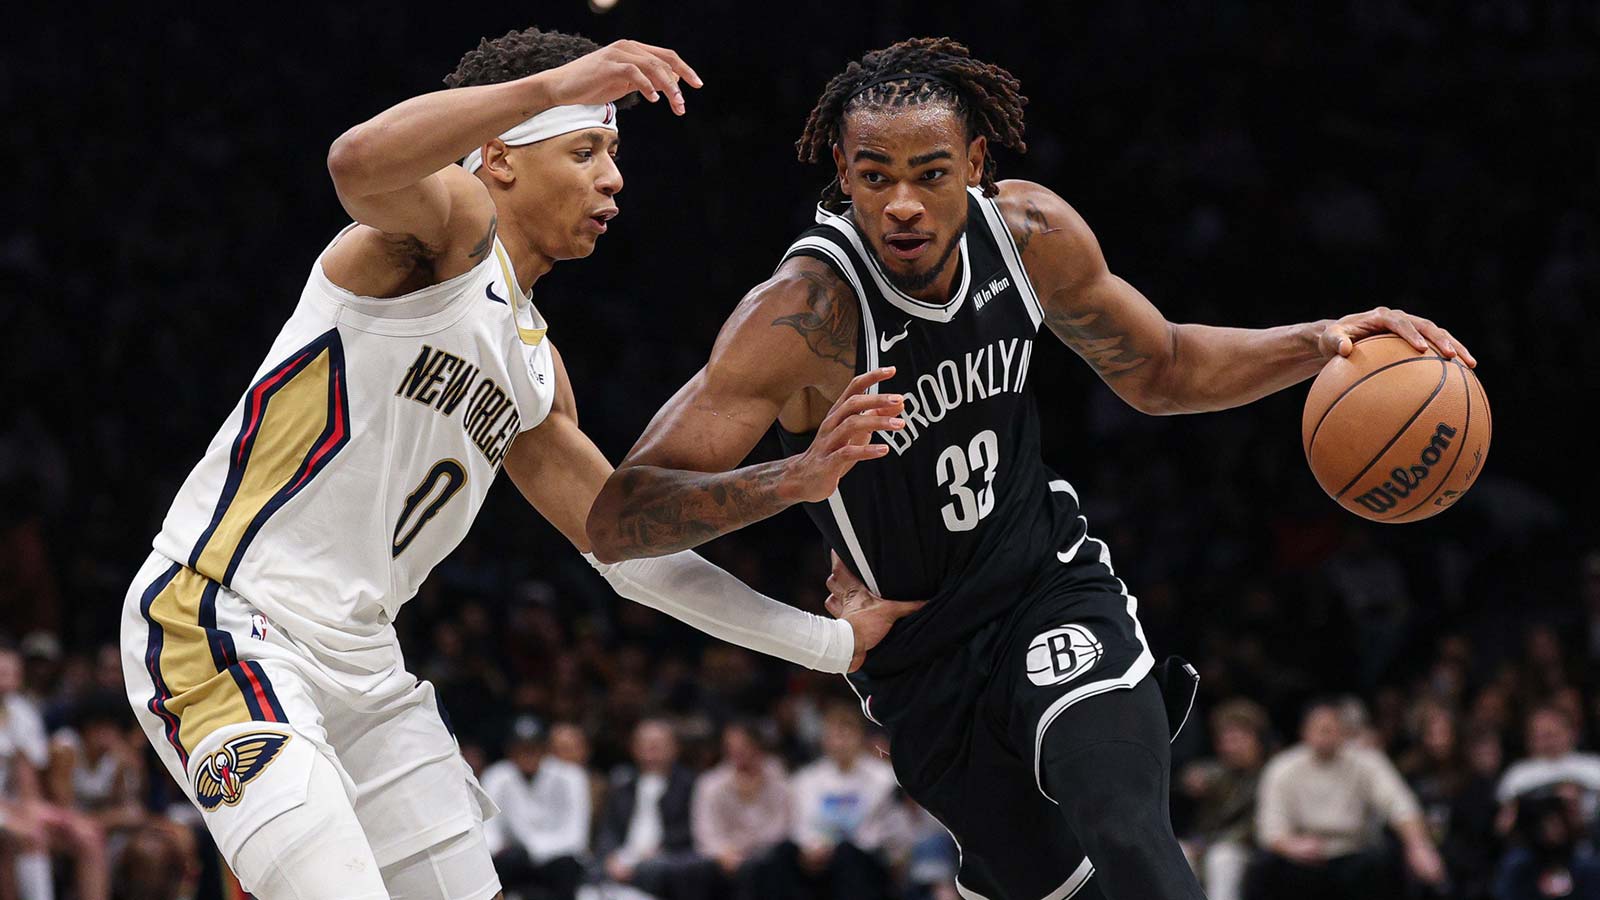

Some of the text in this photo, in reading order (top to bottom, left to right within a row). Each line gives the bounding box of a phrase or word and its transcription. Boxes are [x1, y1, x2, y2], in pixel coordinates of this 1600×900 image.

[973, 277, 1010, 311] All In Won
[395, 344, 520, 474] NEW ORLE
[876, 338, 1033, 456] BROOKLYN
[392, 458, 468, 560] 0
[936, 430, 999, 531] 33
[1353, 422, 1457, 513] Wilson
[1047, 633, 1077, 678] B
